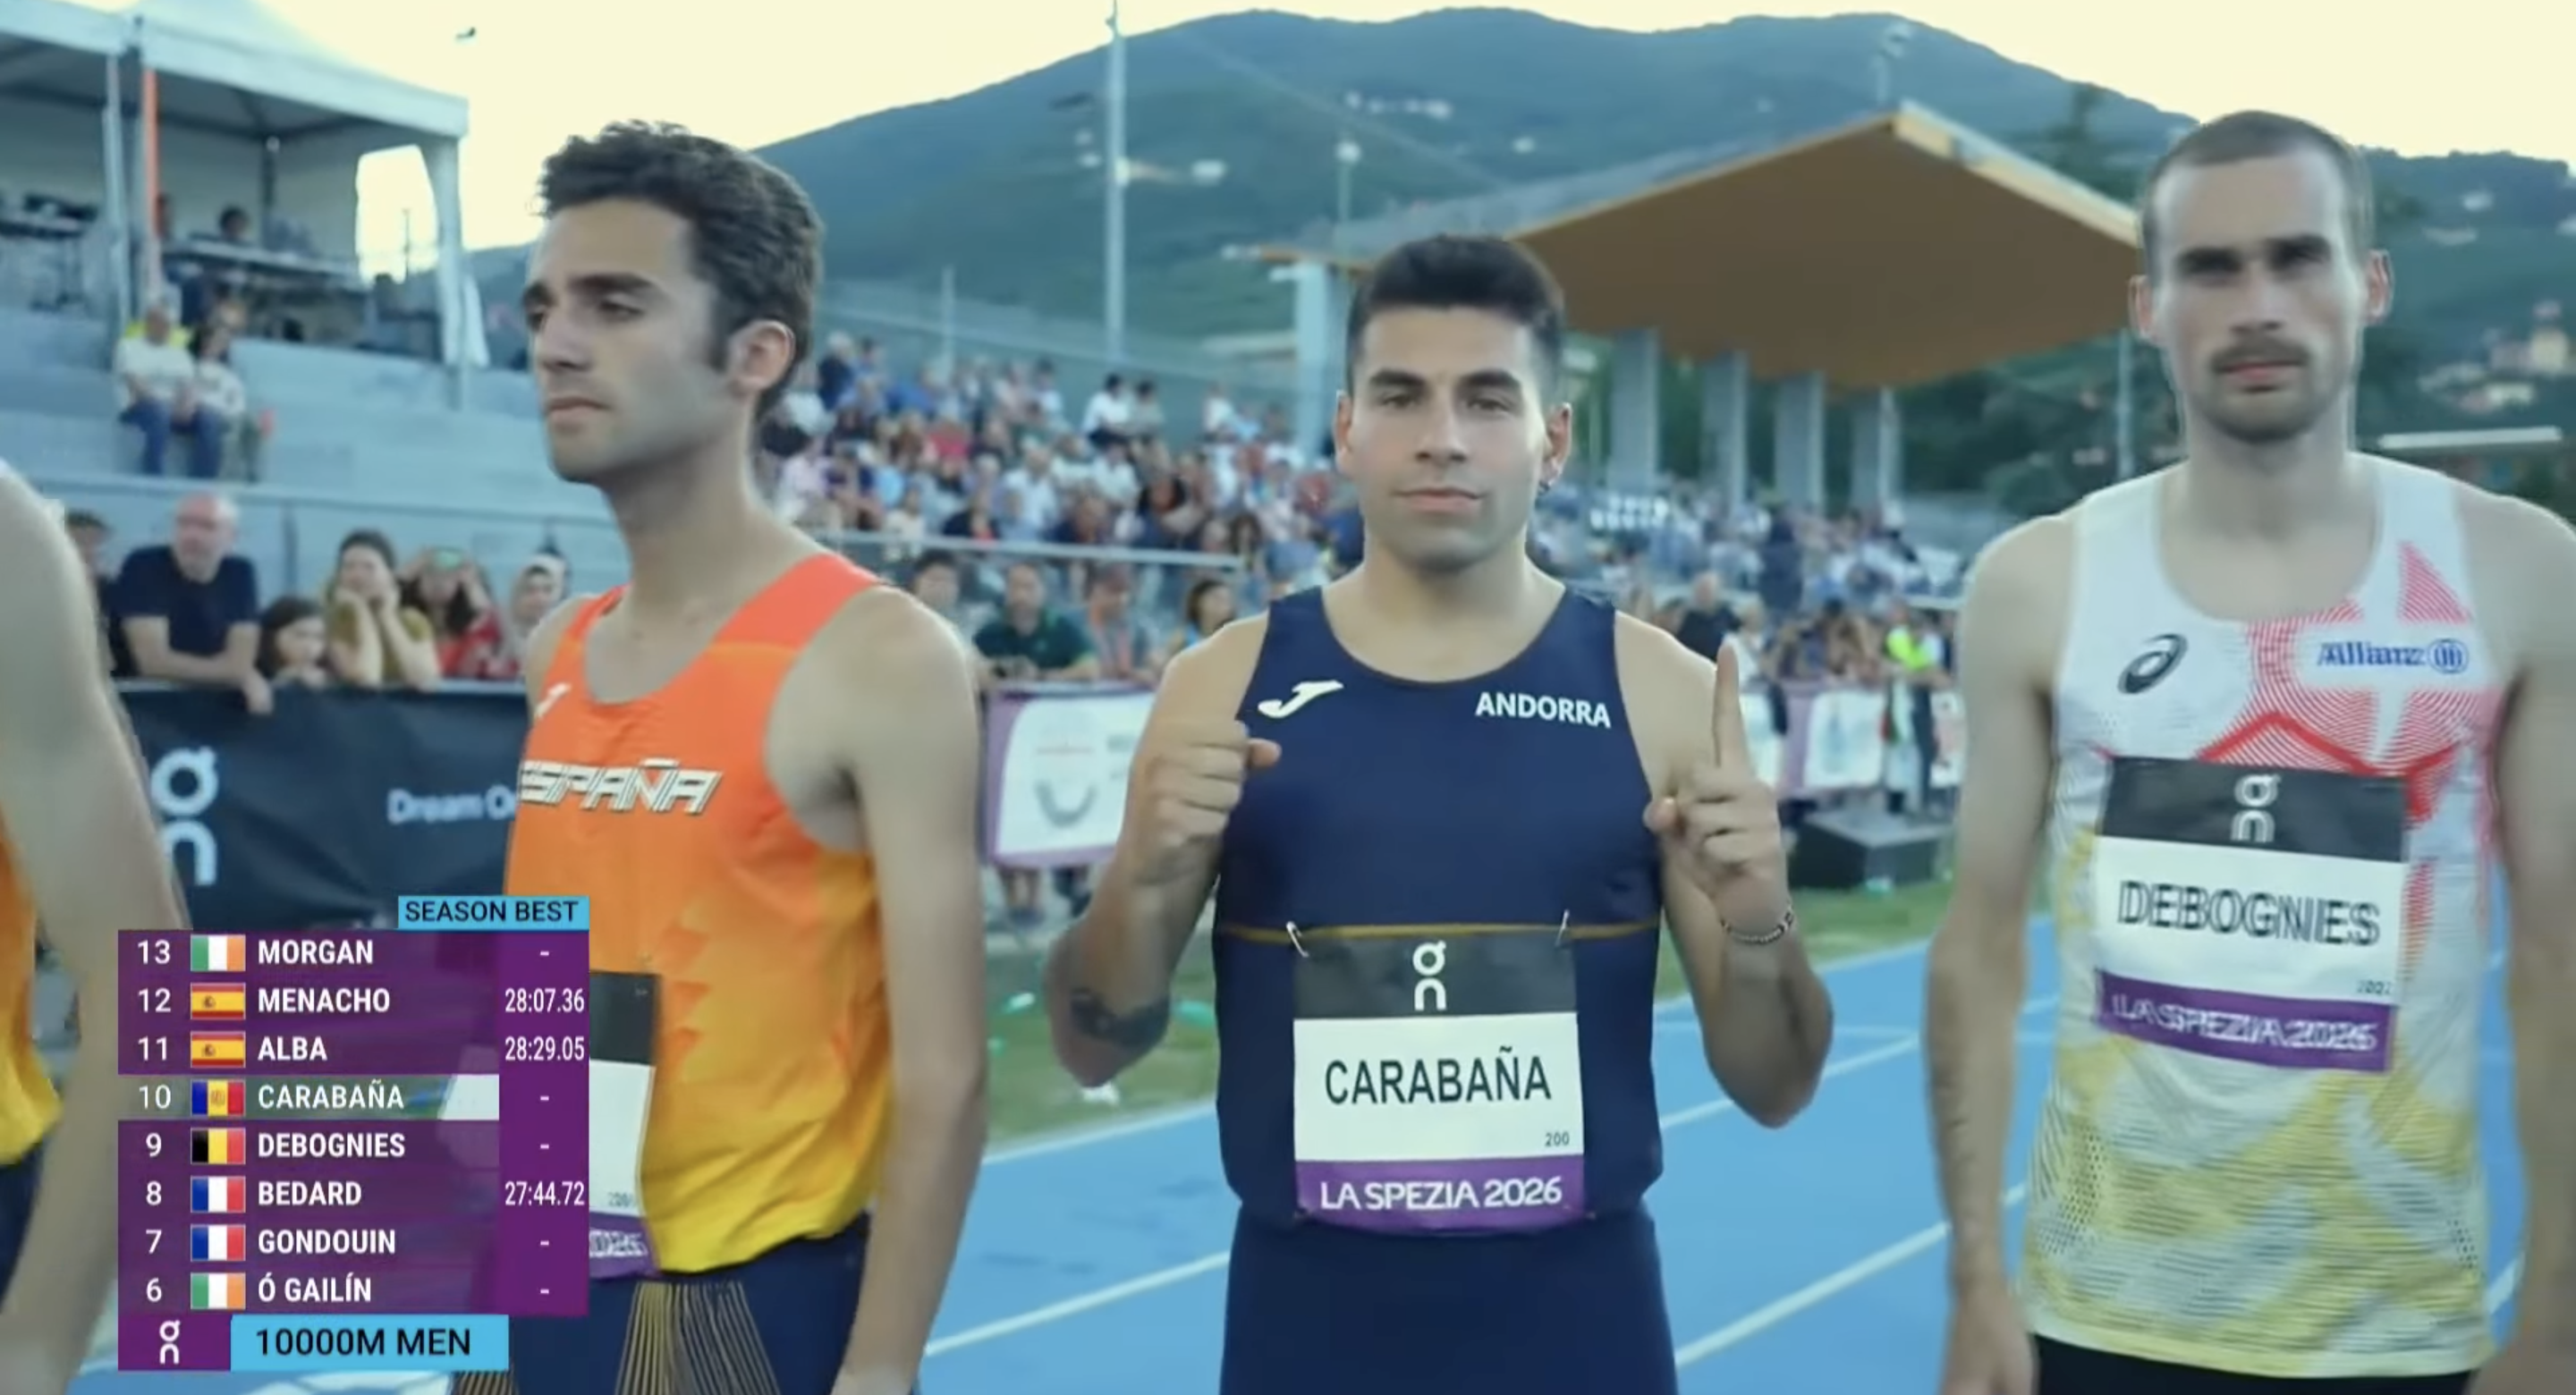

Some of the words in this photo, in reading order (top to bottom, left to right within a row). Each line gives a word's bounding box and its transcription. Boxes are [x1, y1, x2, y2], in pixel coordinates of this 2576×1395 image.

[2317, 641, 2427, 666] Allianz
[1474, 690, 1612, 729] ANDORRA
[486, 784, 516, 821] O
[2117, 880, 2380, 946] DEBOGNIES
[1325, 1044, 1553, 1105] CARABAÑA
[1545, 1131, 1571, 1148] 200
[1320, 1181, 1361, 1210] LA
[1364, 1179, 1480, 1211] SPEZIA
[1483, 1175, 1563, 1208] 2026
